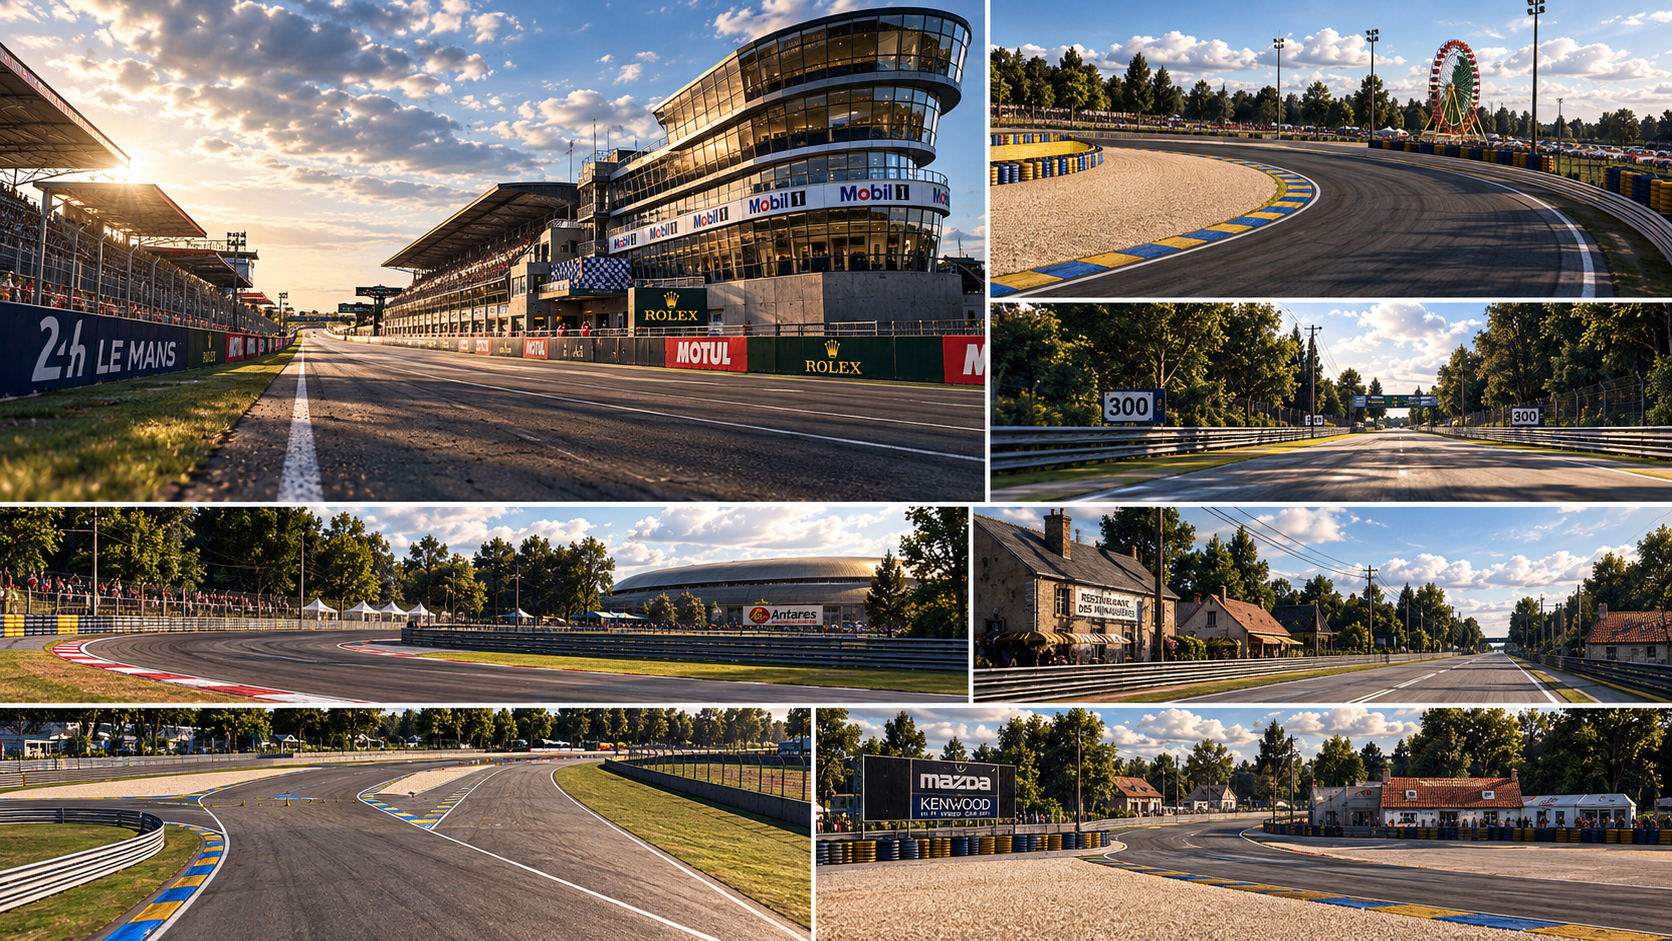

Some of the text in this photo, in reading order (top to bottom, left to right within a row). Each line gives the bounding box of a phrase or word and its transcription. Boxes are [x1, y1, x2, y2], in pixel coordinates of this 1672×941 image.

[840, 184, 892, 202] Mobil
[749, 193, 788, 214] Mobil
[693, 209, 718, 229] Mobil
[650, 223, 670, 240] Mobil
[644, 310, 698, 321] ROLEX
[96, 339, 124, 375] LE
[127, 340, 177, 371] MANS
[676, 341, 731, 365] MOTUL
[805, 360, 862, 374] ROLEX
[1108, 397, 1148, 416] 300
[1514, 411, 1537, 422] 300
[771, 609, 817, 620] Antares
[1078, 604, 1092, 613] DES
[920, 798, 991, 810] KENWOOD
